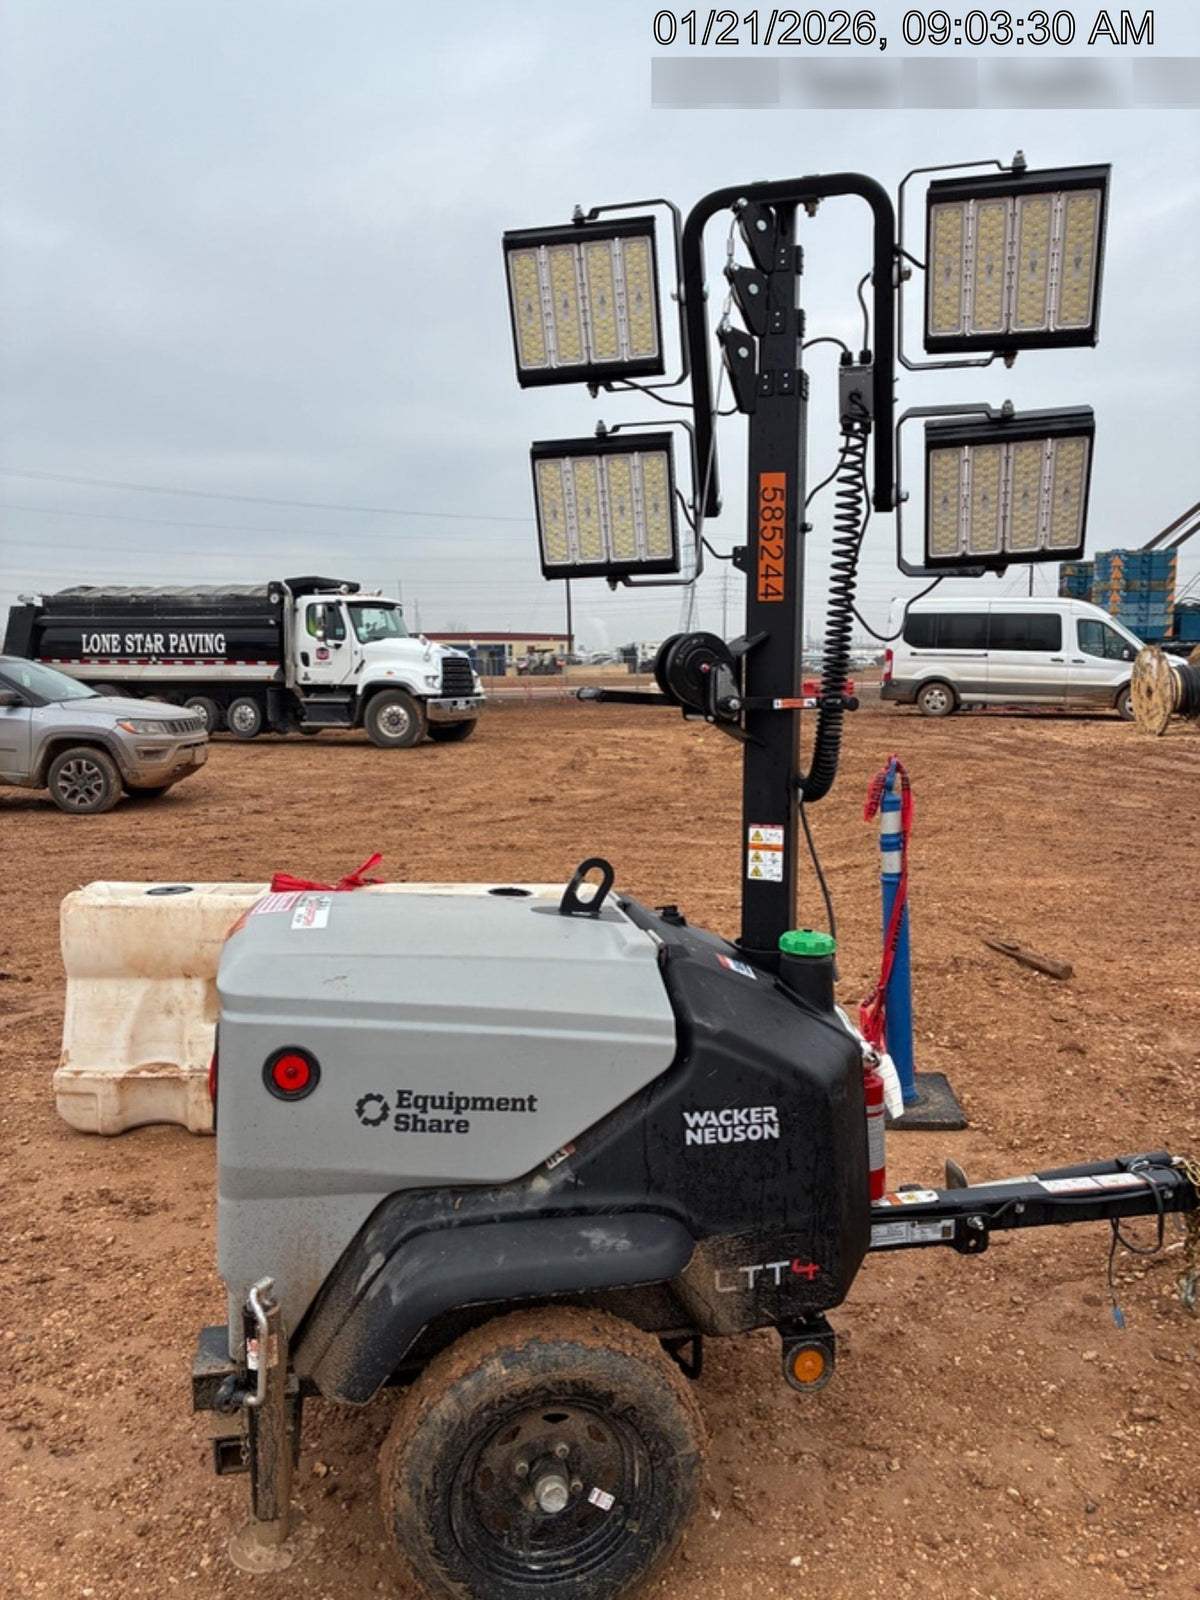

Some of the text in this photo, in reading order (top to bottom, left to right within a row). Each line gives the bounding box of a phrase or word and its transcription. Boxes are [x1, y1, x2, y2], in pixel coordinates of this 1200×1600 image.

[759, 485, 785, 601] 585244
[81, 633, 227, 654] LONE STAR PAVING
[395, 1089, 538, 1115] Equipment
[394, 1113, 470, 1134] Share
[683, 1106, 780, 1128] WACKER
[685, 1123, 781, 1146] NEUSON
